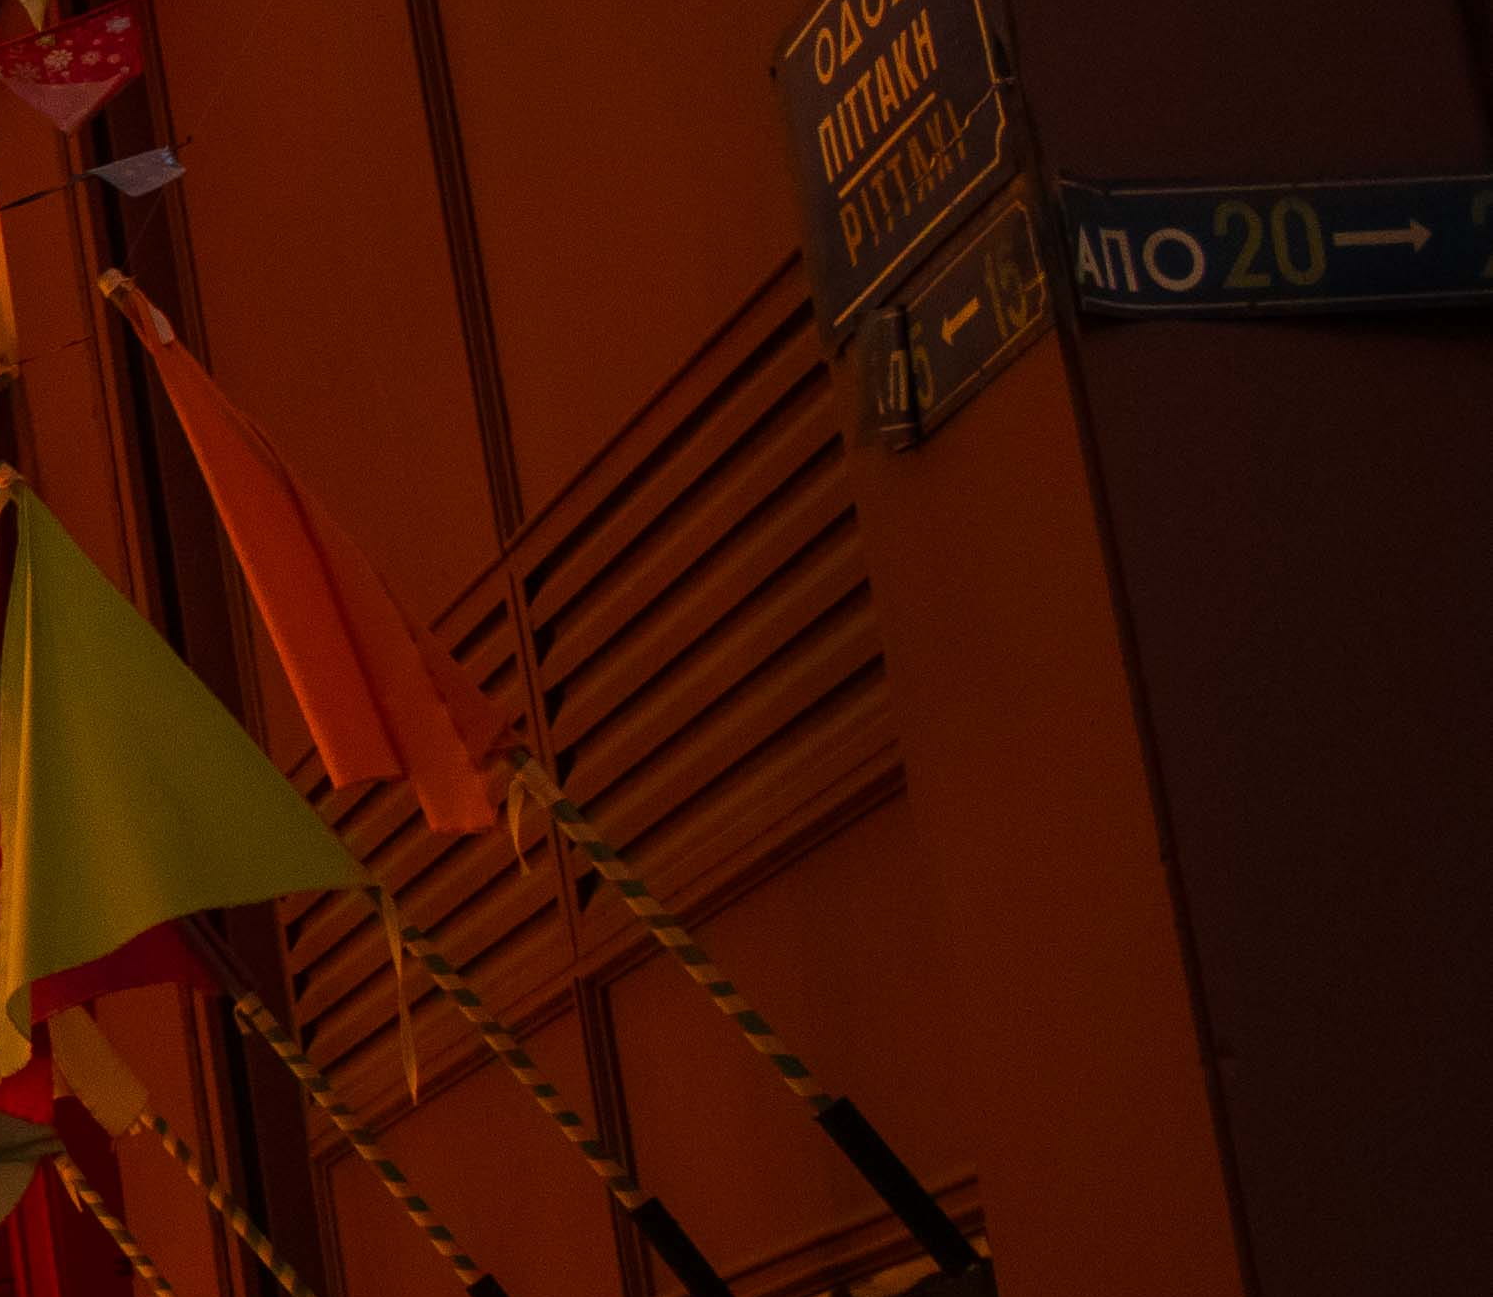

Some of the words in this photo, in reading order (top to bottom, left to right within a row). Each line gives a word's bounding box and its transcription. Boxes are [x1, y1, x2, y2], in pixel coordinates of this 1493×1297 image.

[818, 7, 938, 183] ΠΙΤΤΑΚΗ
[838, 98, 968, 267] PITTAKI
[1076, 225, 1206, 293] ΑΠΟ
[1212, 200, 1328, 290] 20
